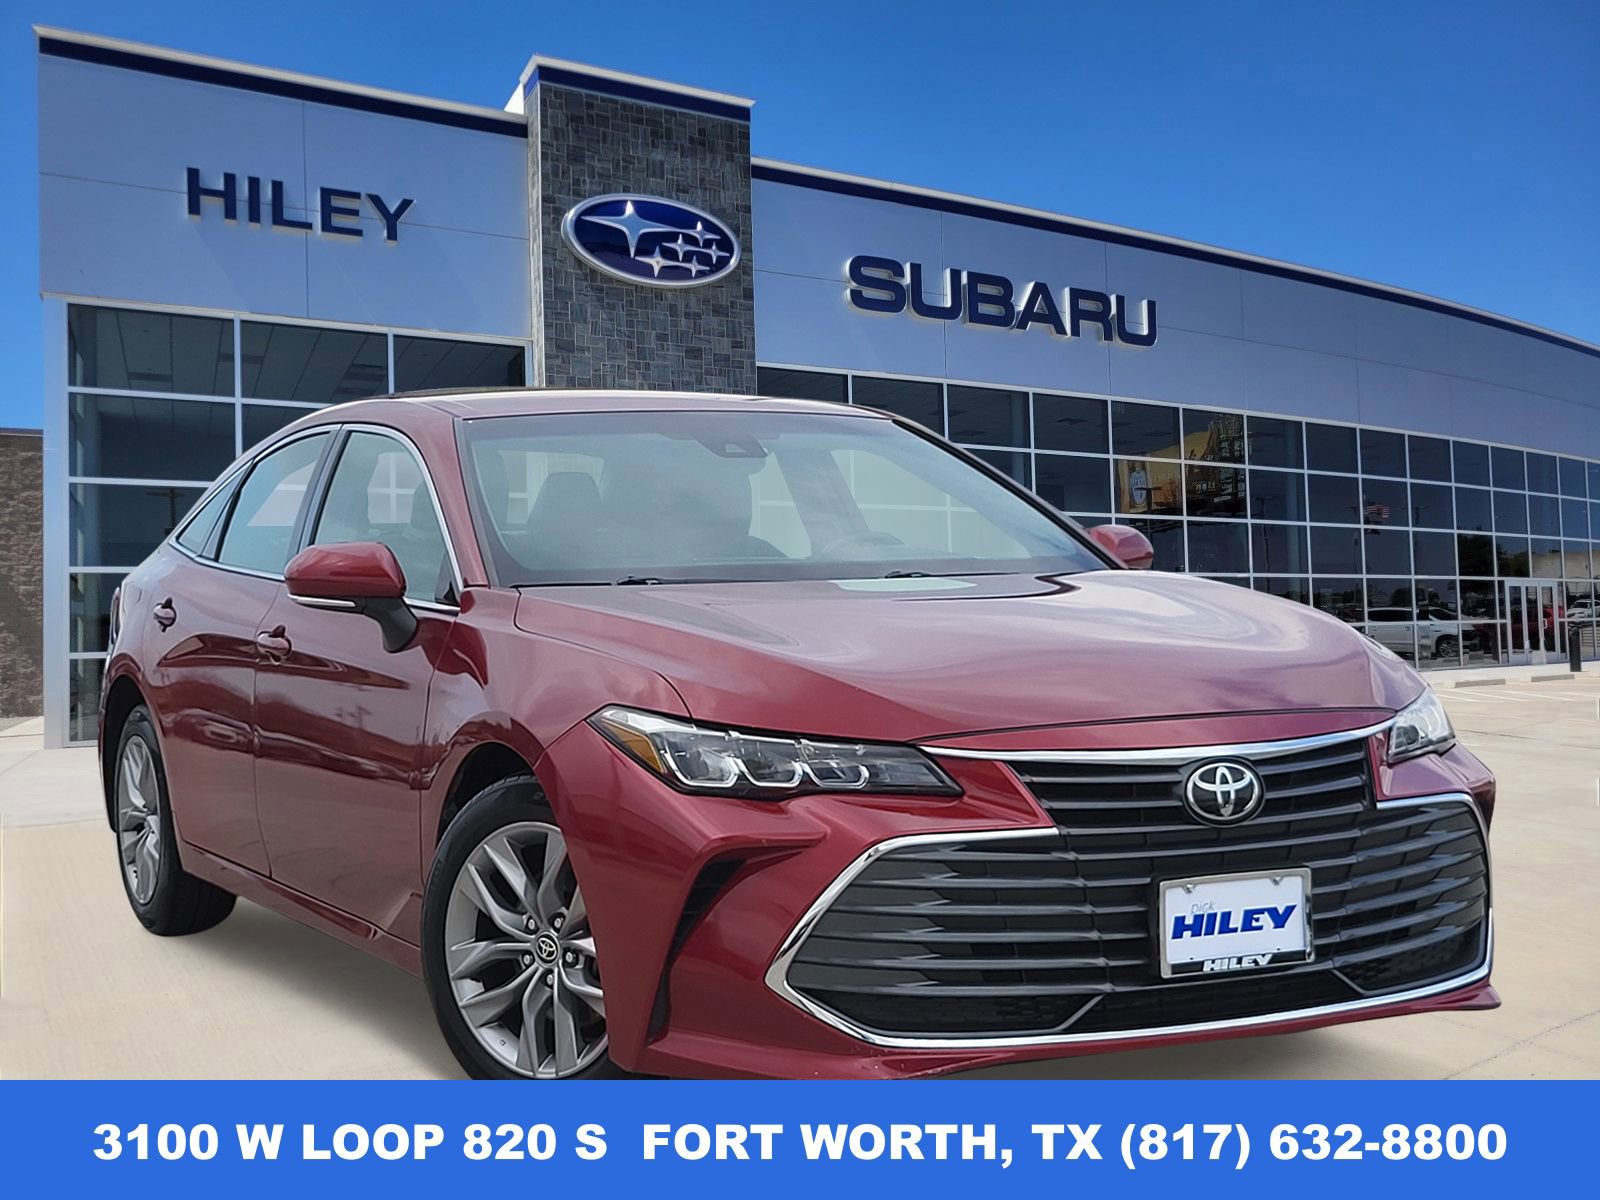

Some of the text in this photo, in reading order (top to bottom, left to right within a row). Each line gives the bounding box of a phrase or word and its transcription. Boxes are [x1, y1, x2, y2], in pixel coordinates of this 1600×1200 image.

[187, 167, 415, 242] HILEY
[846, 254, 1158, 347] SUBARU
[1171, 904, 1297, 940] HILEY
[1203, 953, 1273, 972] HILEY
